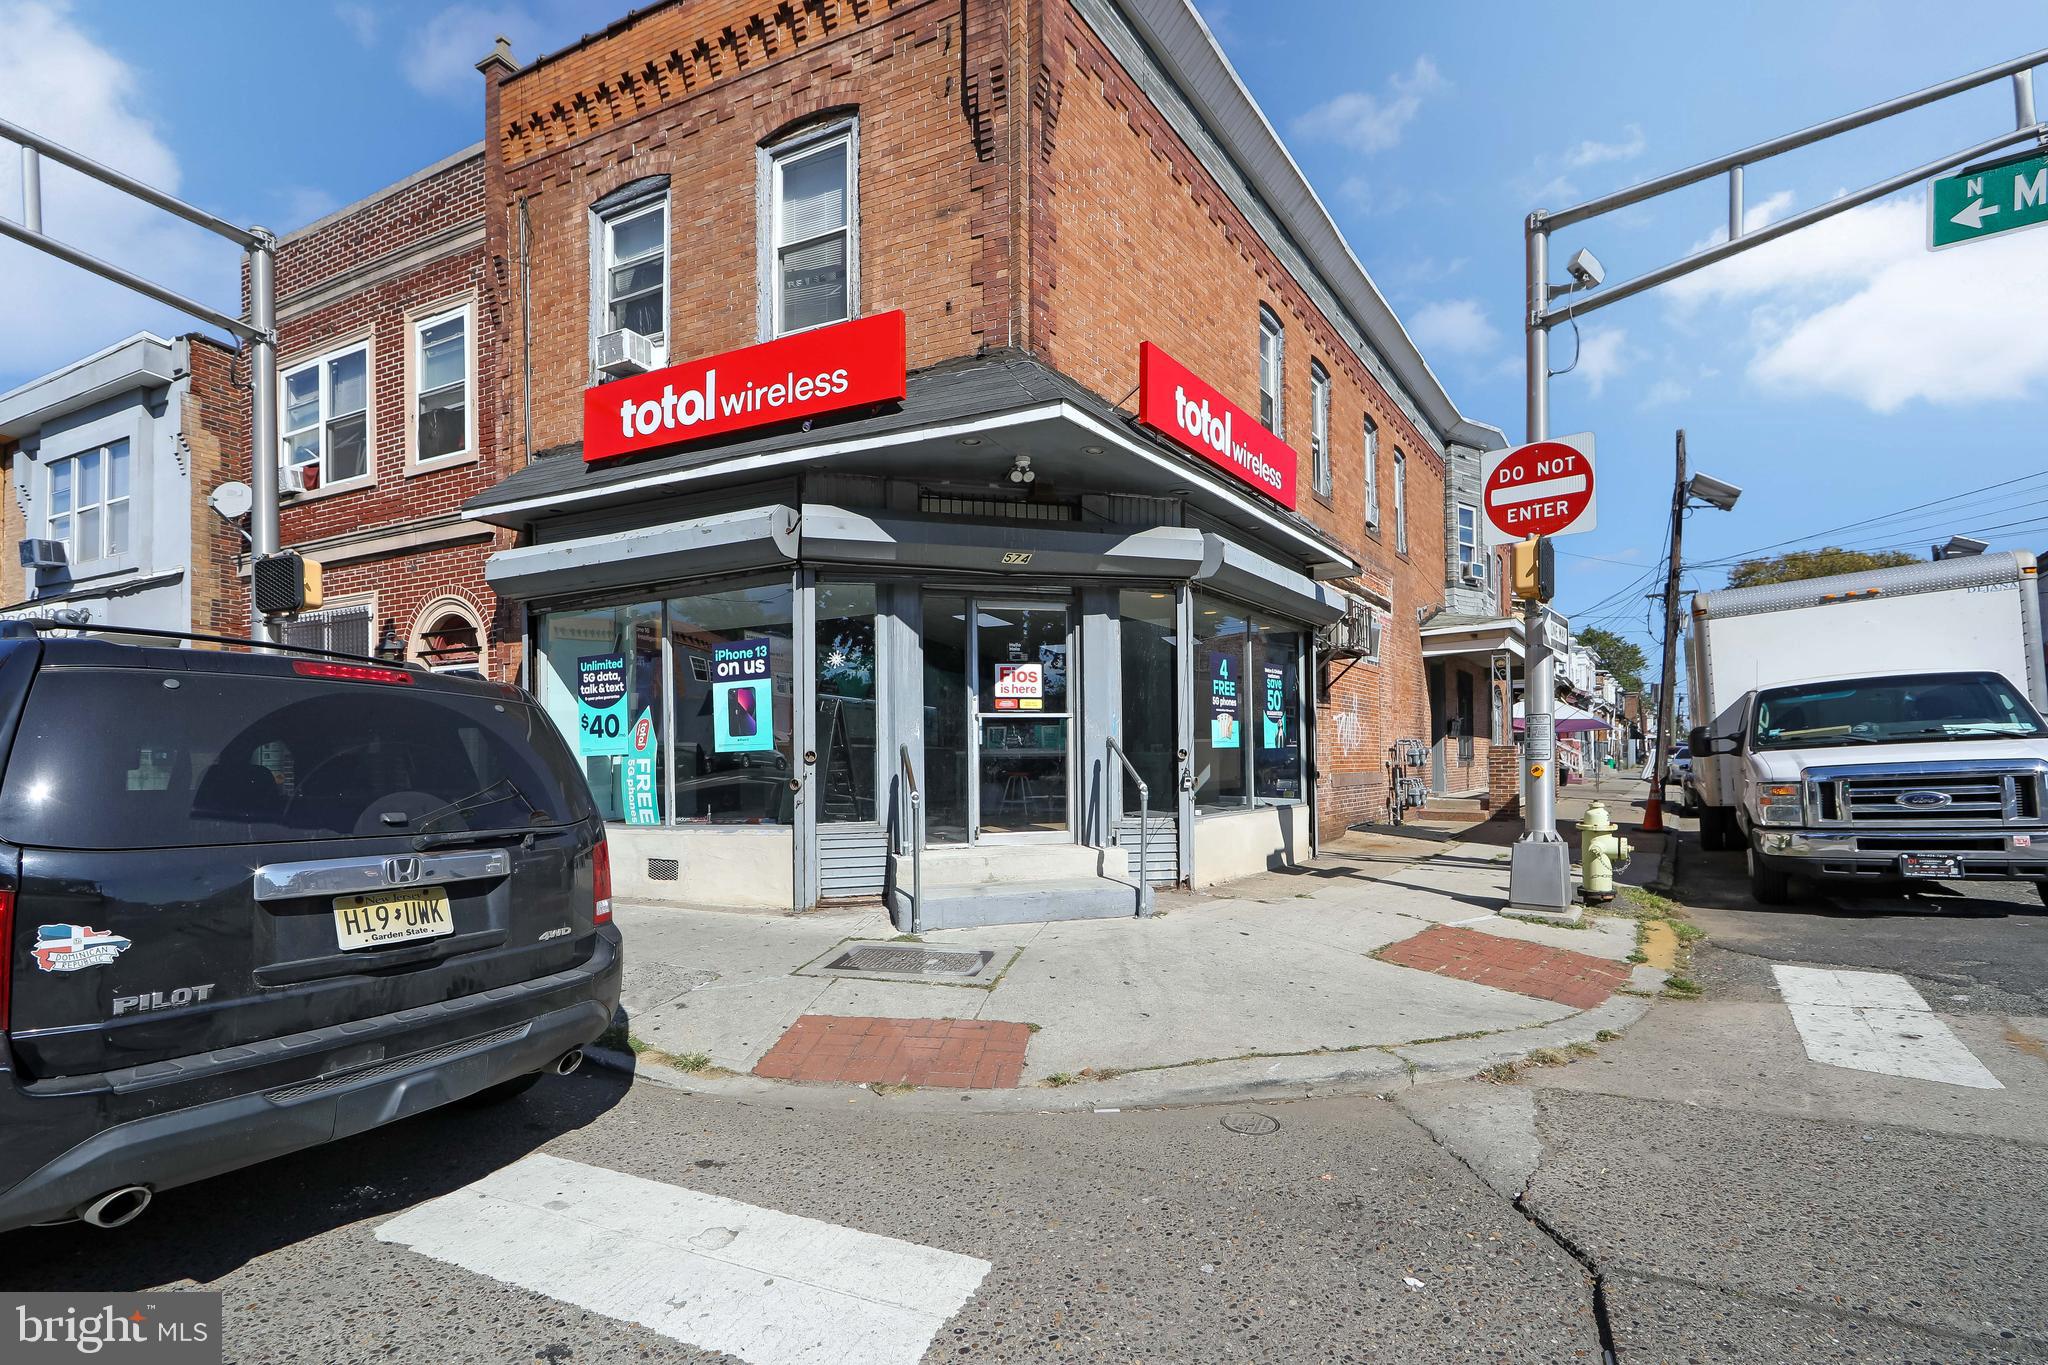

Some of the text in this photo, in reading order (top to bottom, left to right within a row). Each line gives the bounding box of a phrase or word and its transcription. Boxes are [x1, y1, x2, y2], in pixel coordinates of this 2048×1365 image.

[1967, 177, 1983, 198] N
[2014, 168, 2048, 211] M
[620, 368, 849, 438] total wireless
[1175, 385, 1282, 489] total wireless
[1499, 456, 1576, 483] DO NOT
[1507, 500, 1569, 523] ENTER
[1003, 553, 1031, 564] 574
[715, 648, 754, 661] iPhone
[755, 645, 767, 657] 13
[580, 658, 623, 671] Unlimited
[717, 659, 766, 676] on us
[1220, 659, 1228, 680] 4
[583, 671, 621, 683] 5G data,
[1000, 666, 1038, 683] Fios
[580, 682, 624, 695] talk & text
[1000, 684, 1037, 693] is here
[1213, 680, 1236, 696] FREE
[1266, 679, 1282, 689] save
[1212, 696, 1237, 707] 5G phones
[581, 713, 620, 738] $40
[637, 723, 648, 746] total
[627, 760, 638, 823] 5G phones
[636, 758, 655, 824] FREE
[365, 892, 422, 904] New Jersey
[344, 899, 444, 935] H19 UWK
[371, 926, 429, 942] Garden State
[538, 926, 572, 941] 4WD
[55, 946, 108, 961] DOMINICAN
[62, 956, 104, 969] REPUBLIC
[113, 983, 216, 1015] PILOT
